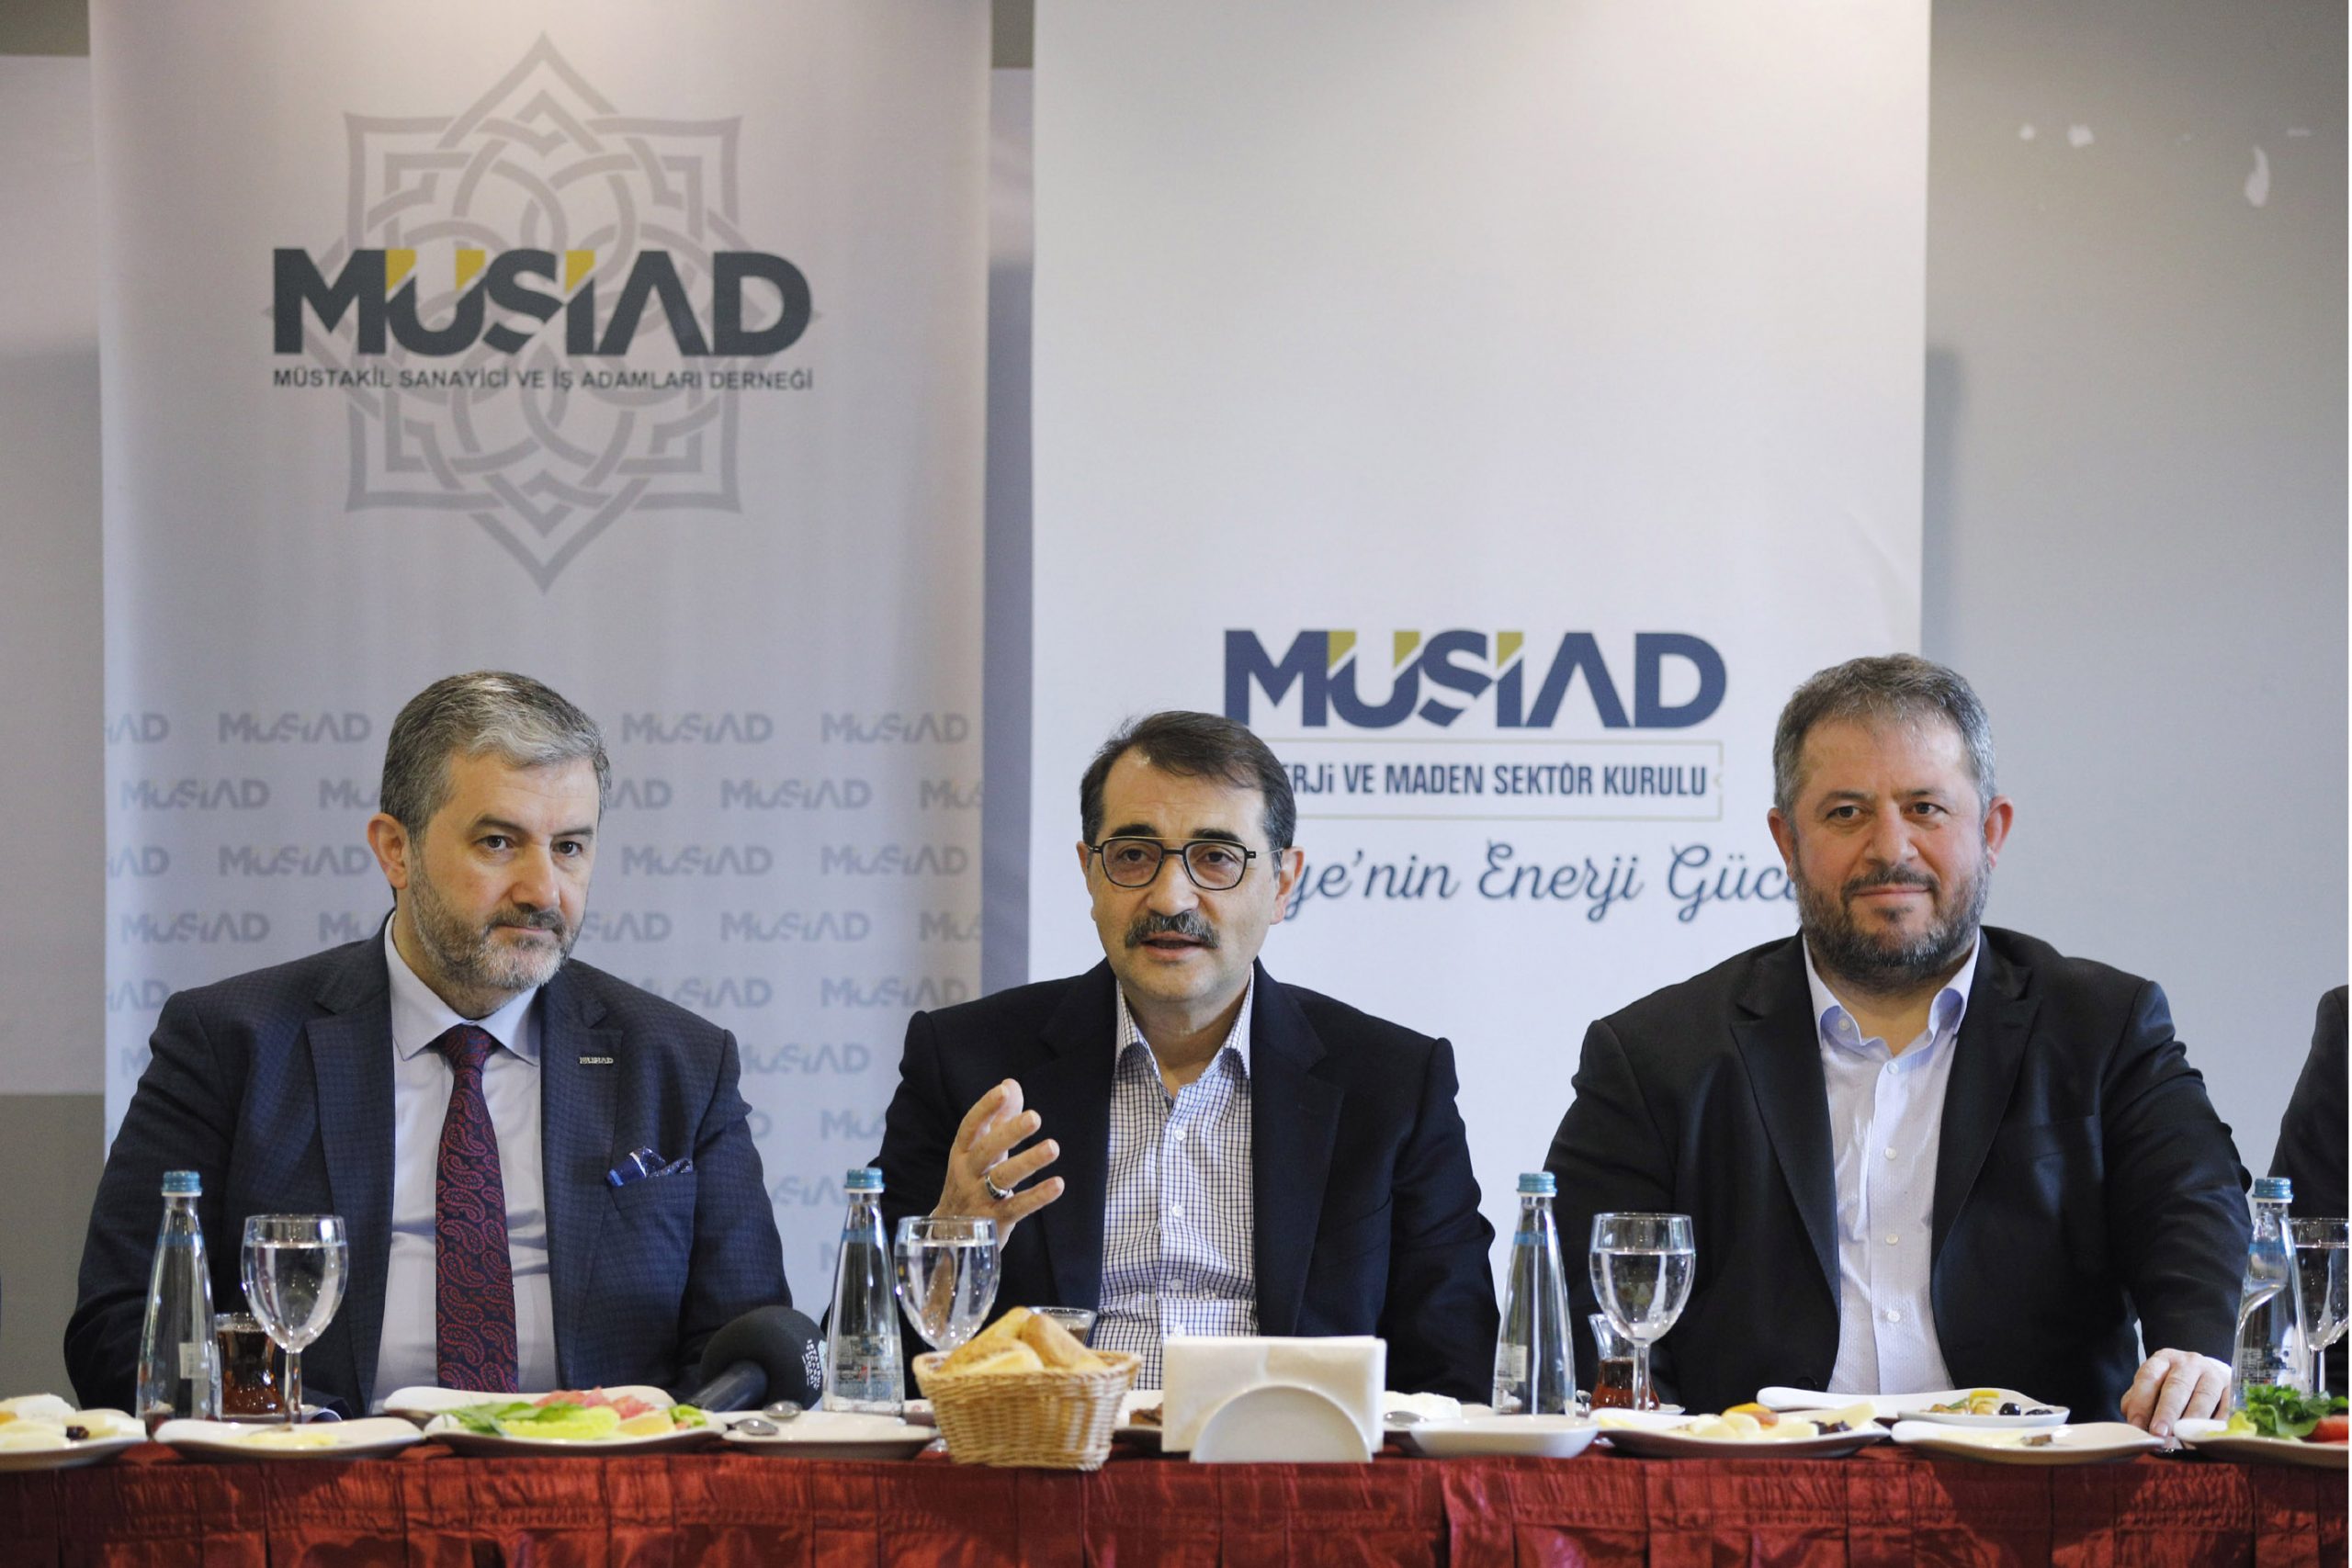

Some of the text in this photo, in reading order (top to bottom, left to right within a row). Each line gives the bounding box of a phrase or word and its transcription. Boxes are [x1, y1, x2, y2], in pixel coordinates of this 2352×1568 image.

[274, 367, 390, 389] MÜSTAKİL
[399, 367, 509, 389] SANAYİCİ
[515, 369, 547, 389] VE
[582, 370, 702, 389] ADAMLARI
[709, 367, 813, 389] DERNEĞİ
[1344, 764, 1374, 794] VE
[1385, 764, 1483, 795] MADEN
[1494, 762, 1593, 795] SEKTÖR
[1604, 765, 1707, 795] KURULU
[1478, 838, 1645, 922] Enerji
